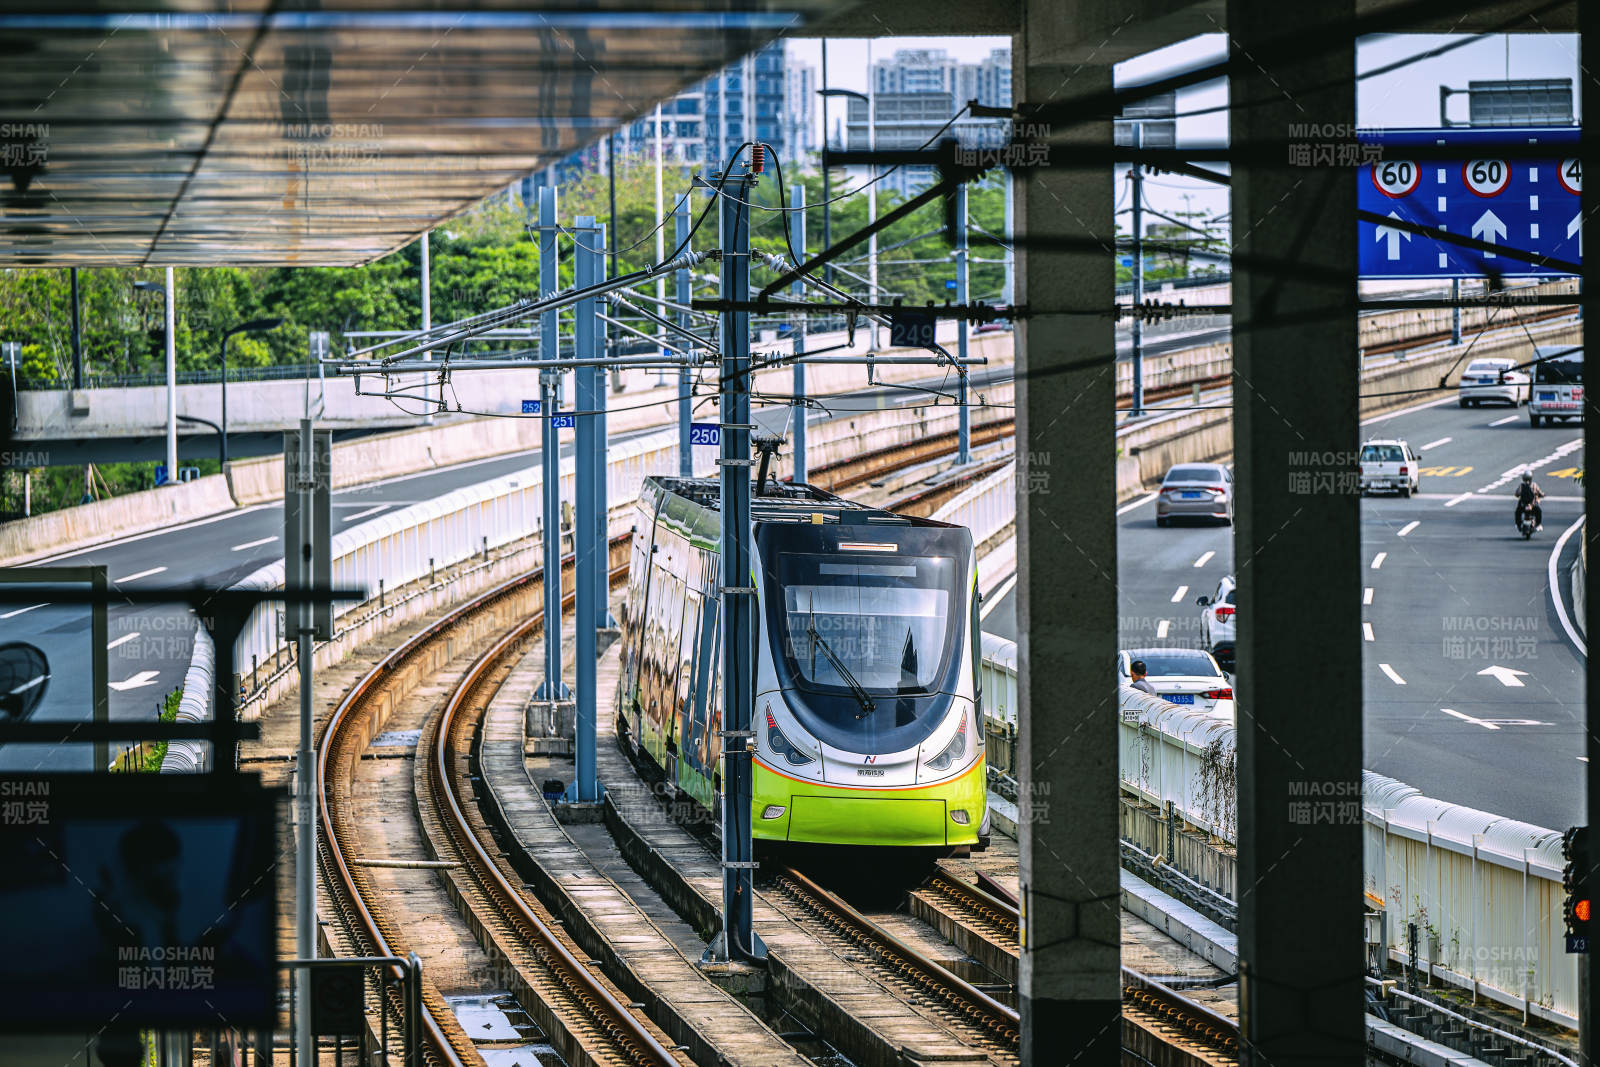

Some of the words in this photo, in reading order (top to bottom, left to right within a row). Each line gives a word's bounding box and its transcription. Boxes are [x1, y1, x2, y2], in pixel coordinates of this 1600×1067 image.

[1381, 161, 1412, 186] 60
[1471, 160, 1501, 184] 60
[894, 324, 933, 345] 249
[522, 403, 540, 412] 252
[553, 416, 573, 427] 251
[691, 429, 719, 444] 250
